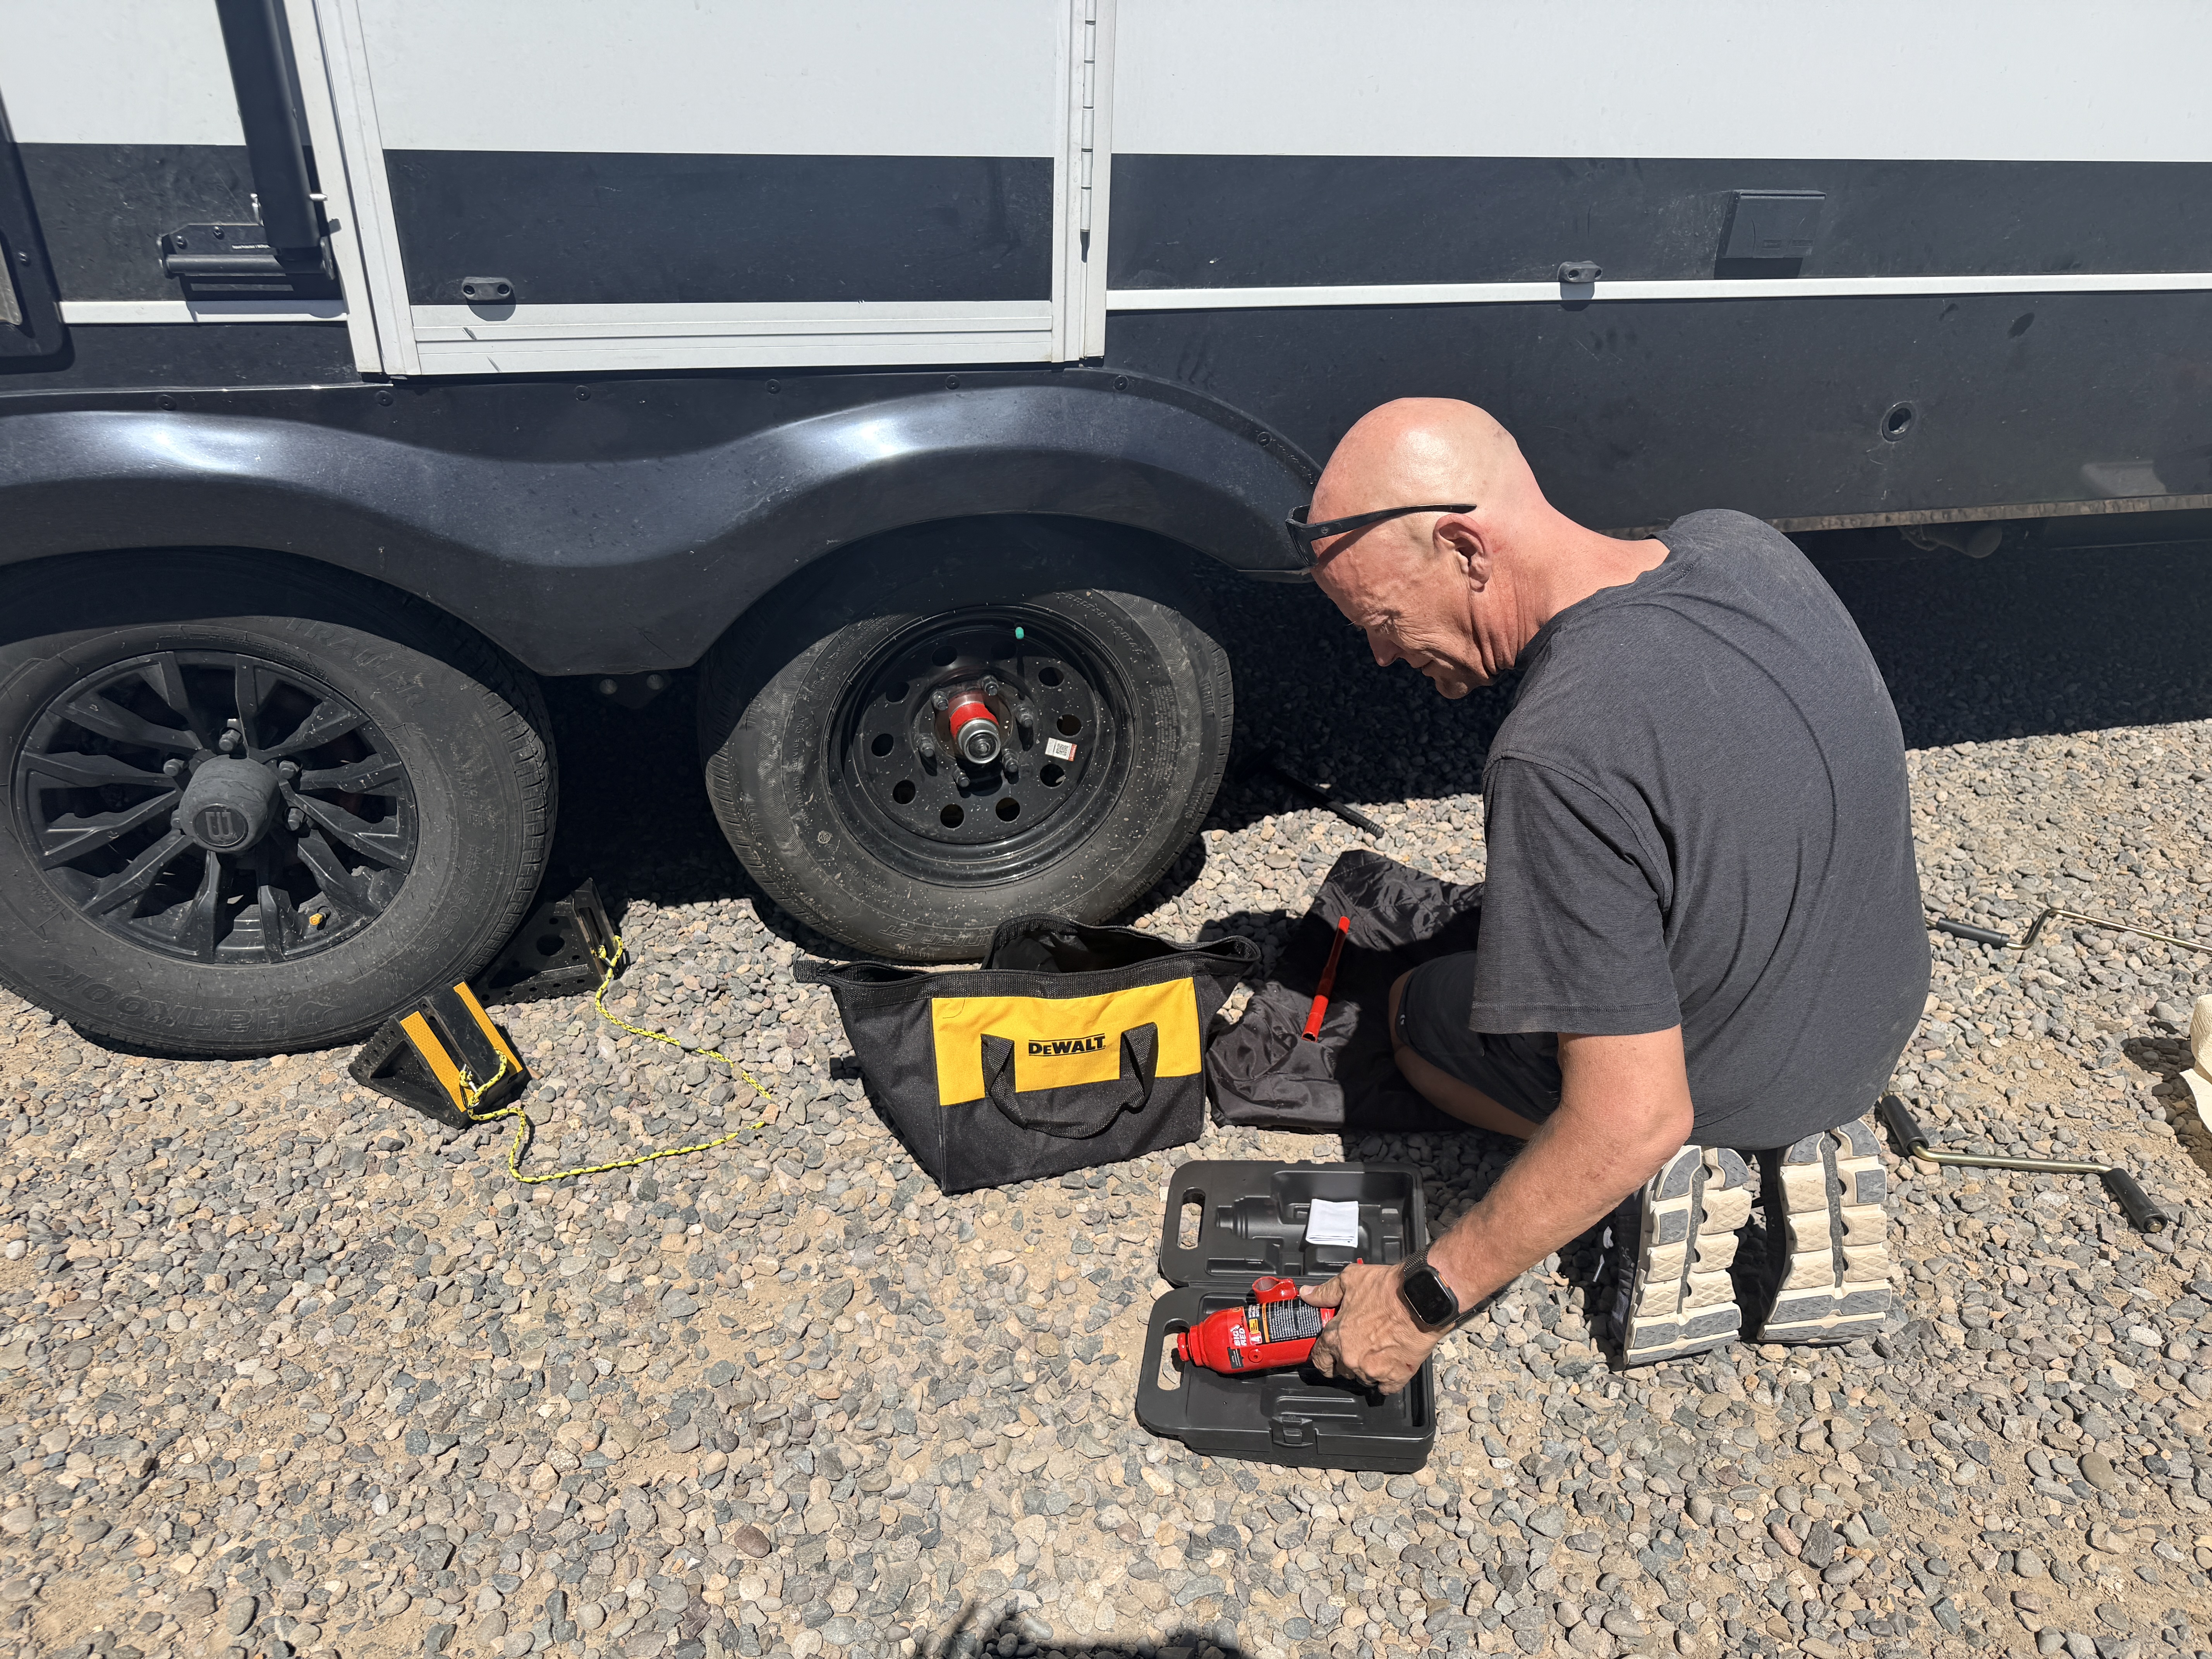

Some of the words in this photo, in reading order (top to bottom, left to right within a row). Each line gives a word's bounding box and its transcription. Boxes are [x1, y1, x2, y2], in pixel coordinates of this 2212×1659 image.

[282, 617, 428, 708] TRAILER
[795, 716, 805, 734] ONLY
[878, 924, 917, 940] ST
[1233, 1330, 1241, 1346] BIG
[1239, 1328, 1248, 1346] RED
